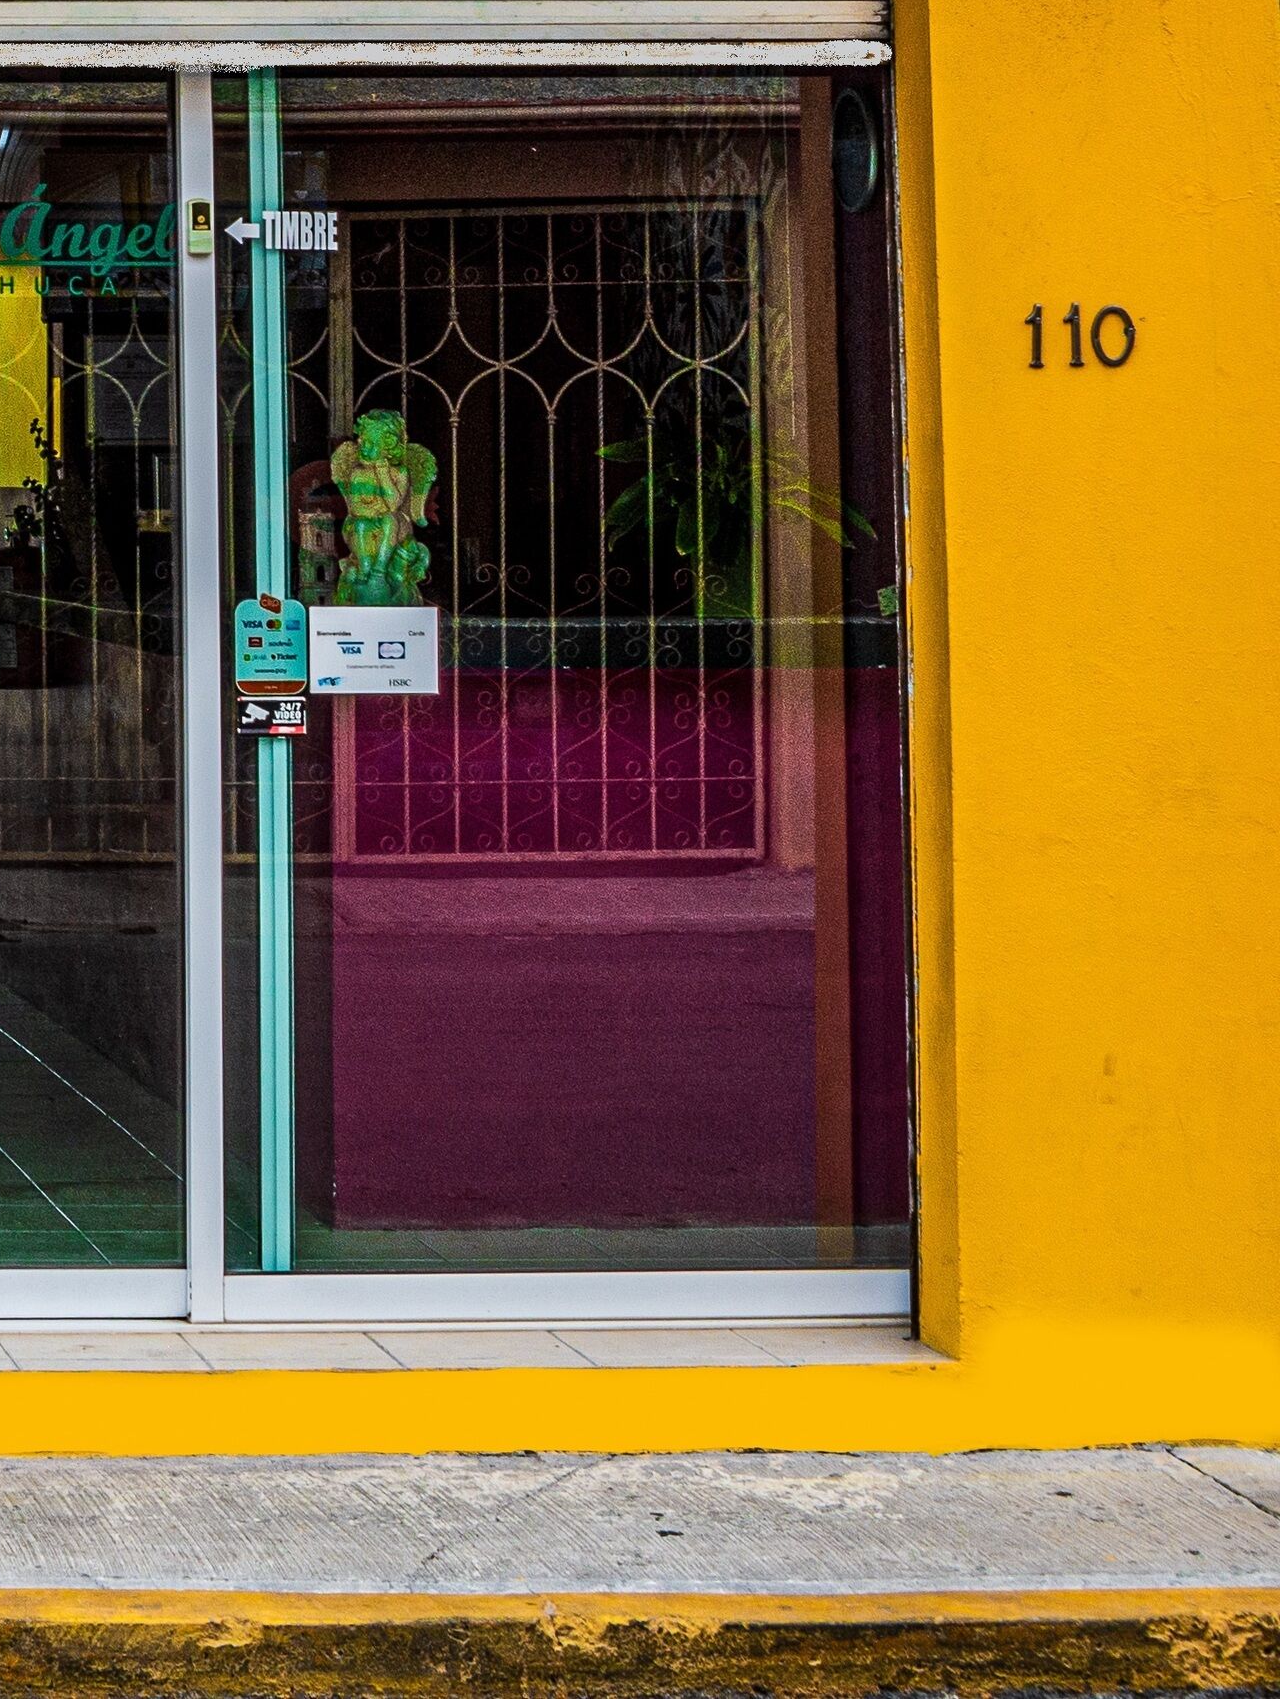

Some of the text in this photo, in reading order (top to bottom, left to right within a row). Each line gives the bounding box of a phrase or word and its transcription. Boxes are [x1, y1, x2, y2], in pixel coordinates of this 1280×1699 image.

[0, 183, 177, 276] Ángel
[262, 210, 339, 251] TIMBRE
[1024, 302, 1137, 369] 110
[241, 620, 264, 629] VISA
[341, 646, 362, 655] VISA
[388, 678, 412, 687] HSBC
[279, 702, 302, 712] 24/7
[273, 710, 302, 720] VIDEO
